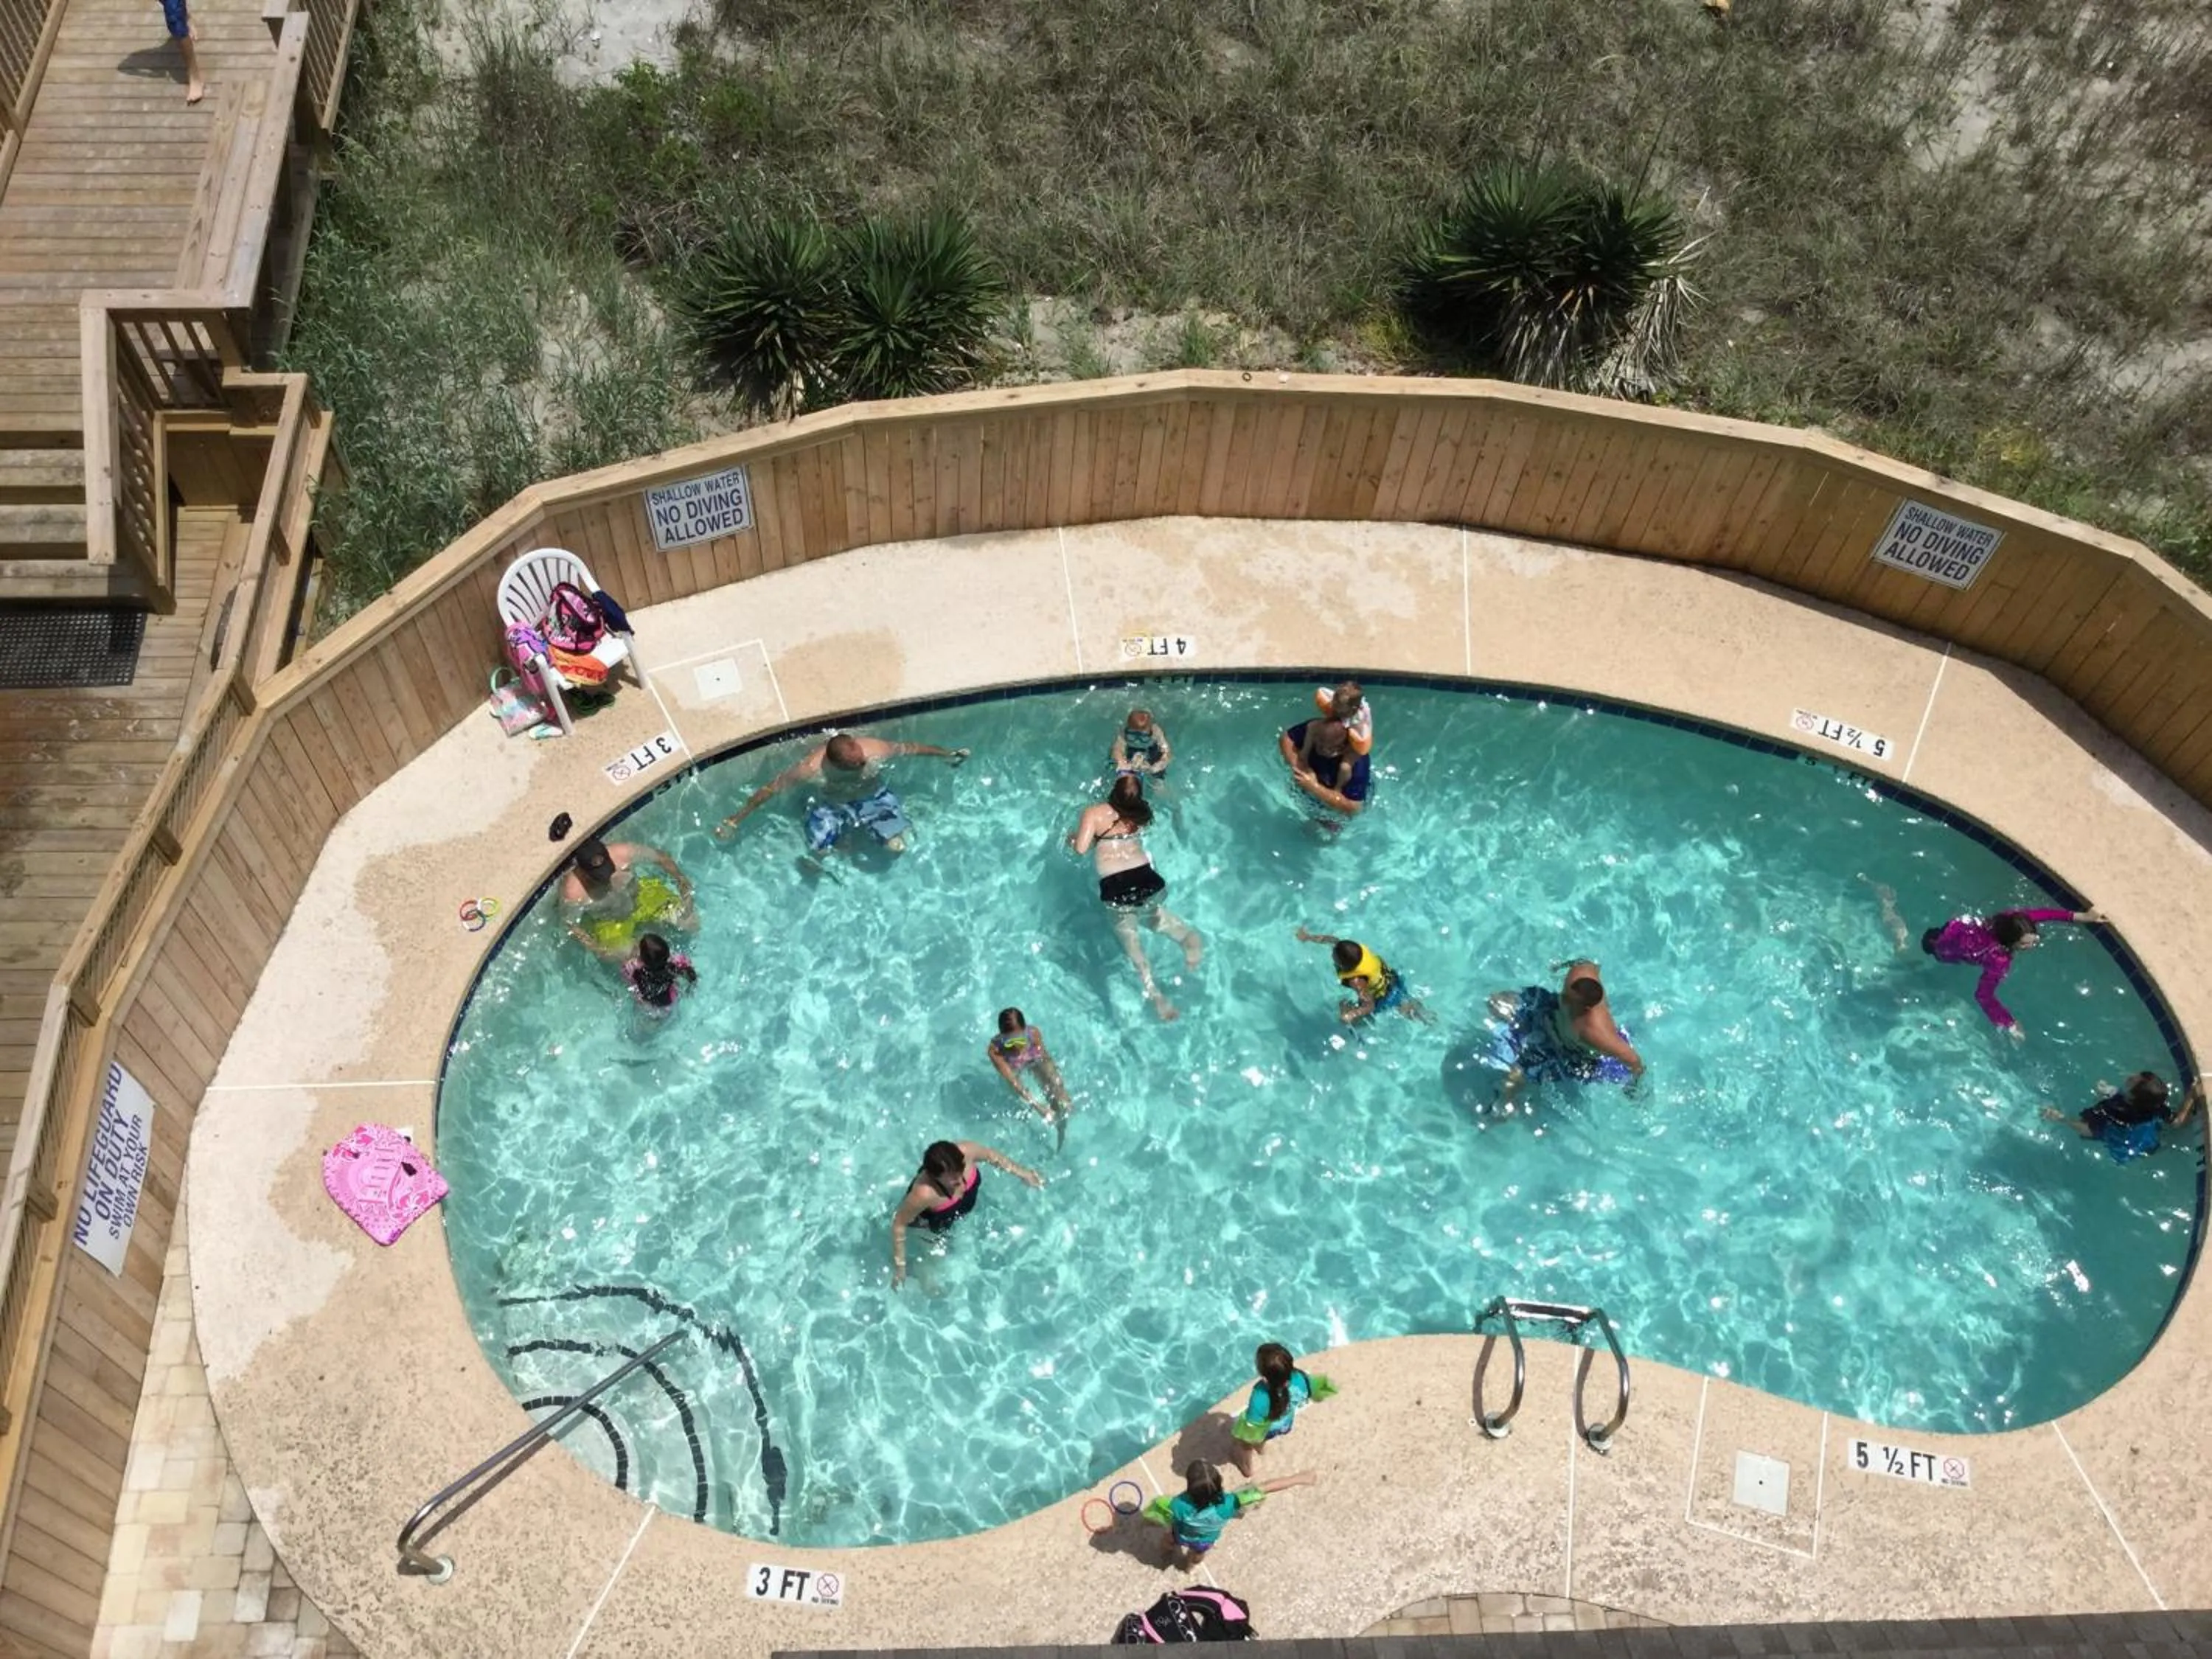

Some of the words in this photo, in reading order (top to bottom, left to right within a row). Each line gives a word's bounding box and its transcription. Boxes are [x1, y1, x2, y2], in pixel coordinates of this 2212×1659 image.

[651, 483, 700, 505] SHALLOW
[705, 472, 740, 492] WATER
[655, 505, 681, 526] NO
[686, 489, 742, 519] DIVING
[665, 508, 743, 543] ALLOWED
[1893, 521, 1922, 543] NO
[1922, 532, 1984, 565] DIVING
[1906, 507, 1957, 534] SHALLOW
[1955, 524, 1994, 547] WATER
[1883, 541, 1970, 580] ALLOWED
[1147, 638, 1168, 655] FT
[1176, 638, 1186, 655] 4
[655, 737, 672, 754] 3
[1818, 720, 1843, 740] FT
[1873, 739, 1885, 757] 5
[630, 745, 656, 771] FT
[104, 1109, 129, 1179] DUTY
[124, 1114, 142, 1159] YOUR
[119, 1163, 131, 1187] AT
[123, 1185, 138, 1227] OWN
[131, 1141, 147, 1183] RISK
[95, 1181, 114, 1220] ON
[109, 1189, 126, 1239] SWIM
[74, 1205, 91, 1245] NO
[1857, 1441, 1869, 1468] 5
[1910, 1451, 1935, 1481] FT
[756, 1567, 771, 1596] 3
[780, 1569, 810, 1600] FT
